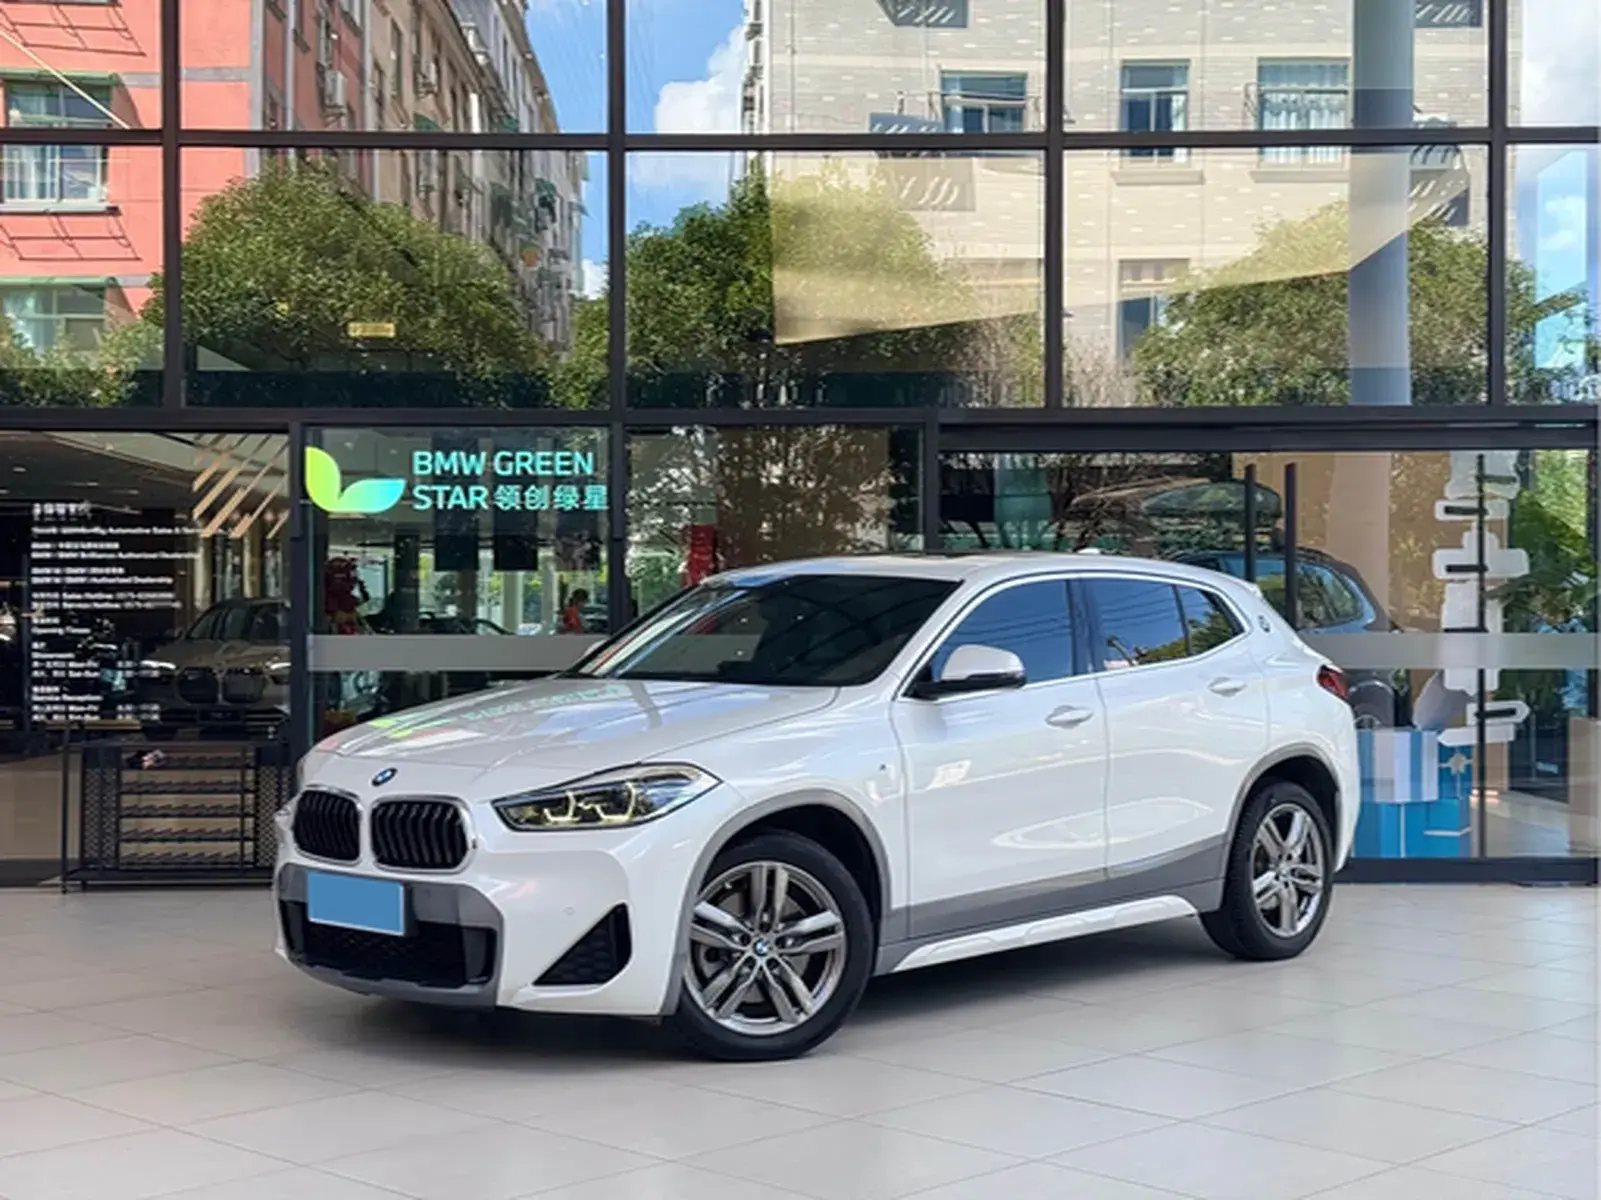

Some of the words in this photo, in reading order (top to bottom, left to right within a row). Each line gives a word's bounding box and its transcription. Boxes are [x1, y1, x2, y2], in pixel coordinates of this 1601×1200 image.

[412, 451, 487, 475] BMW
[493, 450, 594, 476] GREEN
[412, 484, 490, 510] STAR
[494, 483, 610, 511] 领创绿星
